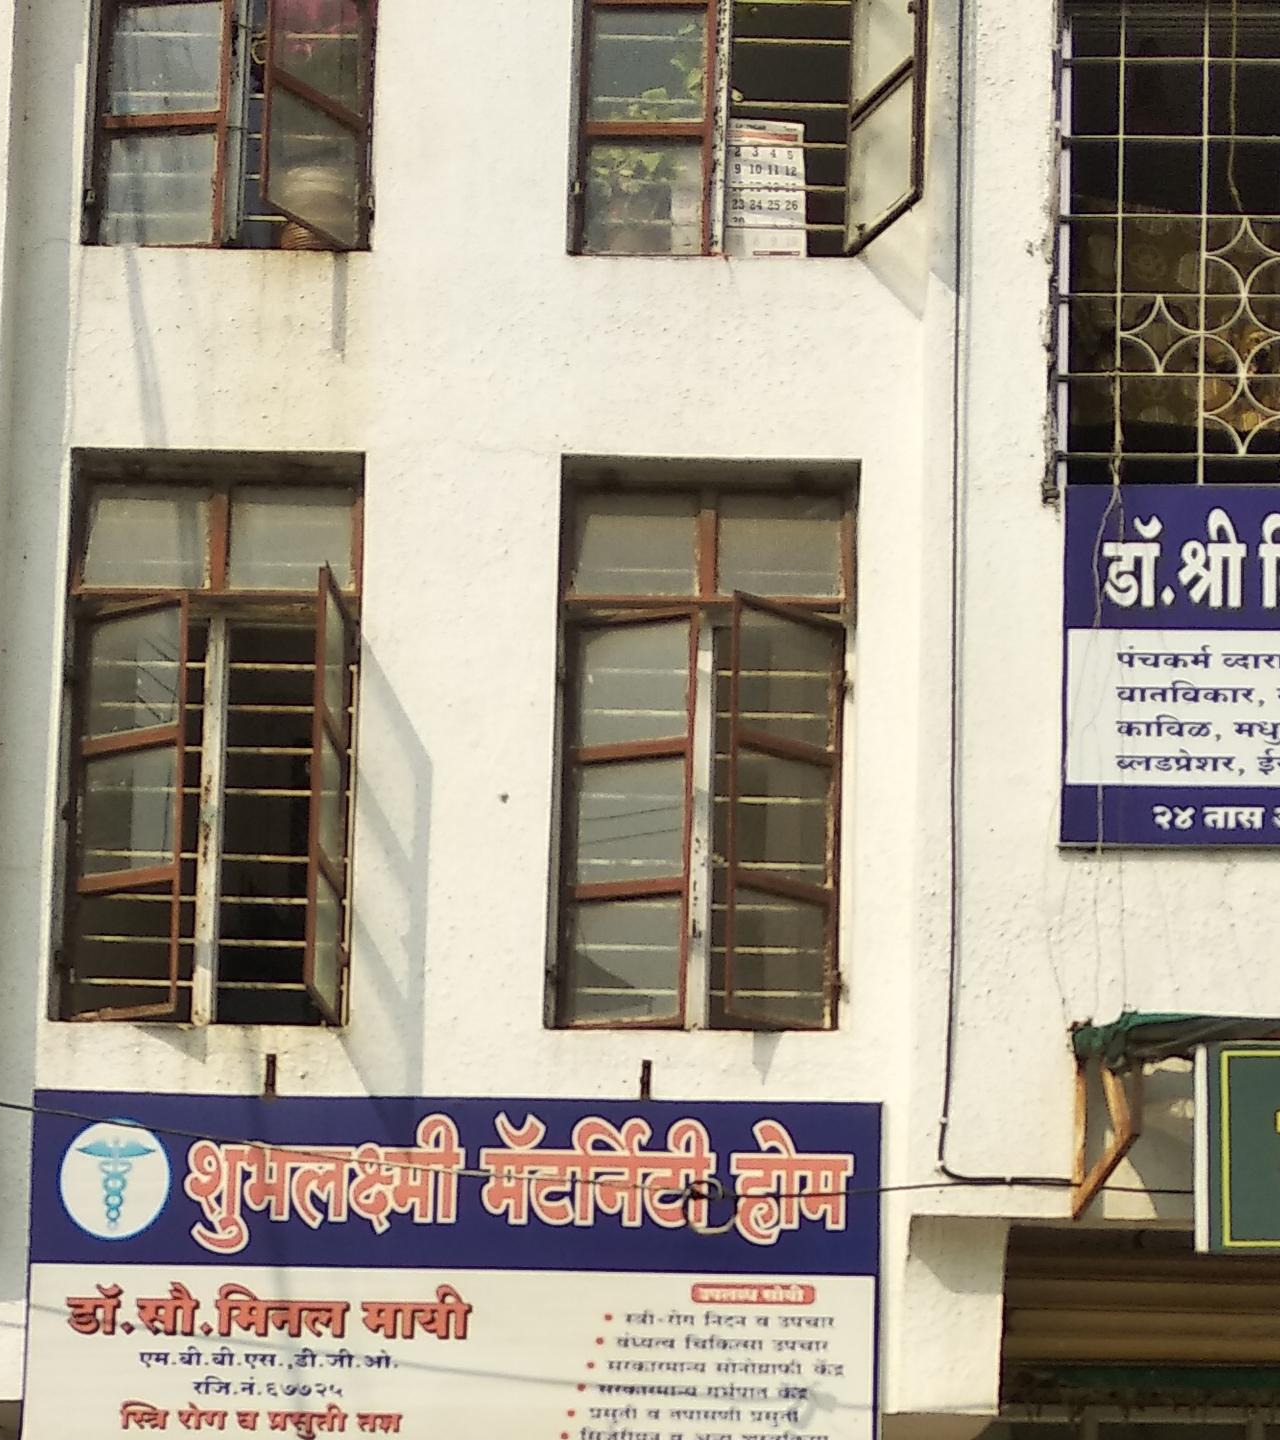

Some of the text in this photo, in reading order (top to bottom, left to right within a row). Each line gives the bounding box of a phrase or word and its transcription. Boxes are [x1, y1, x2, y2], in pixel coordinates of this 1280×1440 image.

[734, 164, 797, 176] 9 10 11 12
[732, 199, 798, 211] 23 24 25 26
[1117, 645, 1212, 671] पंचकर्म
[1116, 680, 1266, 708] वातविकार,
[1116, 714, 1222, 743] काविळ,
[1116, 748, 1247, 777] ब्लडप्रेशर,
[1152, 805, 1196, 831] २४
[1202, 805, 1266, 831] तास
[184, 1111, 854, 1255] शुभलक्ष्मी मॅटर्निटी होम
[361, 1283, 474, 1341] मायी
[178, 1401, 227, 1431] रोग
[236, 1409, 260, 1431] व
[268, 1402, 348, 1440] प्रसुती
